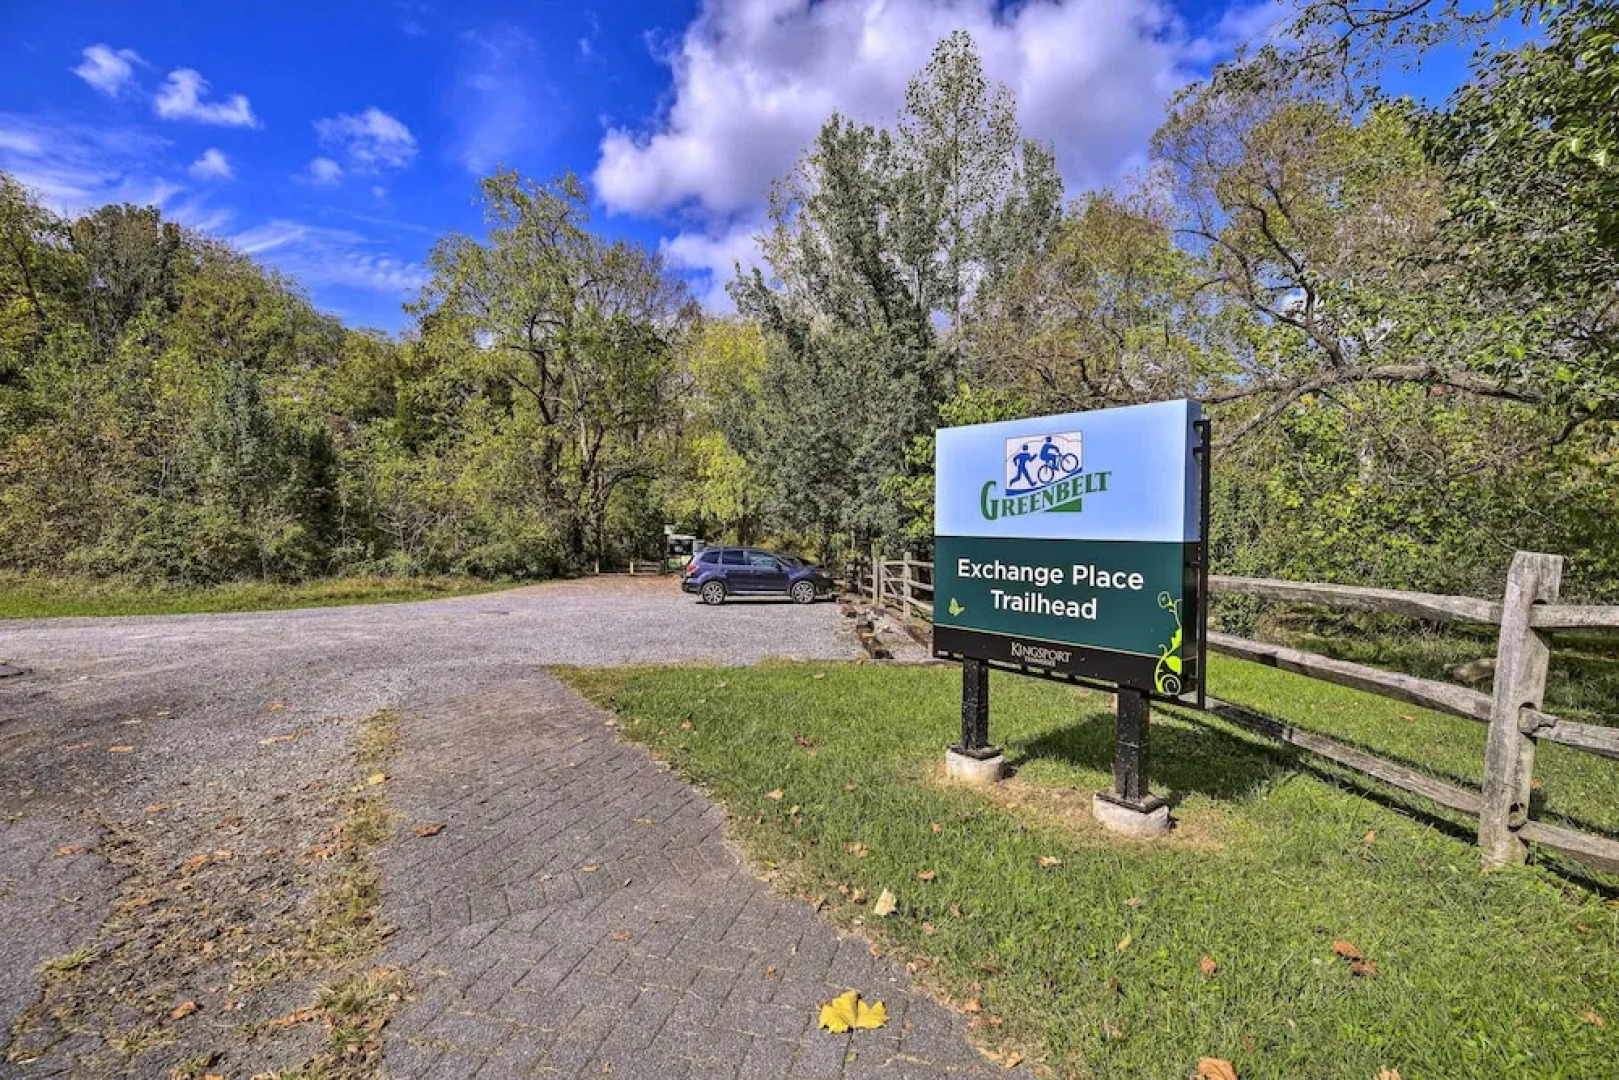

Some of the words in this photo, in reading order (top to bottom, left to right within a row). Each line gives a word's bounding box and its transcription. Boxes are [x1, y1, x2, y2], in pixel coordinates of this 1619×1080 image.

[981, 471, 1111, 520] GREENBELT
[957, 558, 1064, 587] Exchange
[1072, 565, 1144, 590] Place
[990, 589, 1097, 620] Trailhead
[1011, 642, 1072, 663] KINGSPORT
